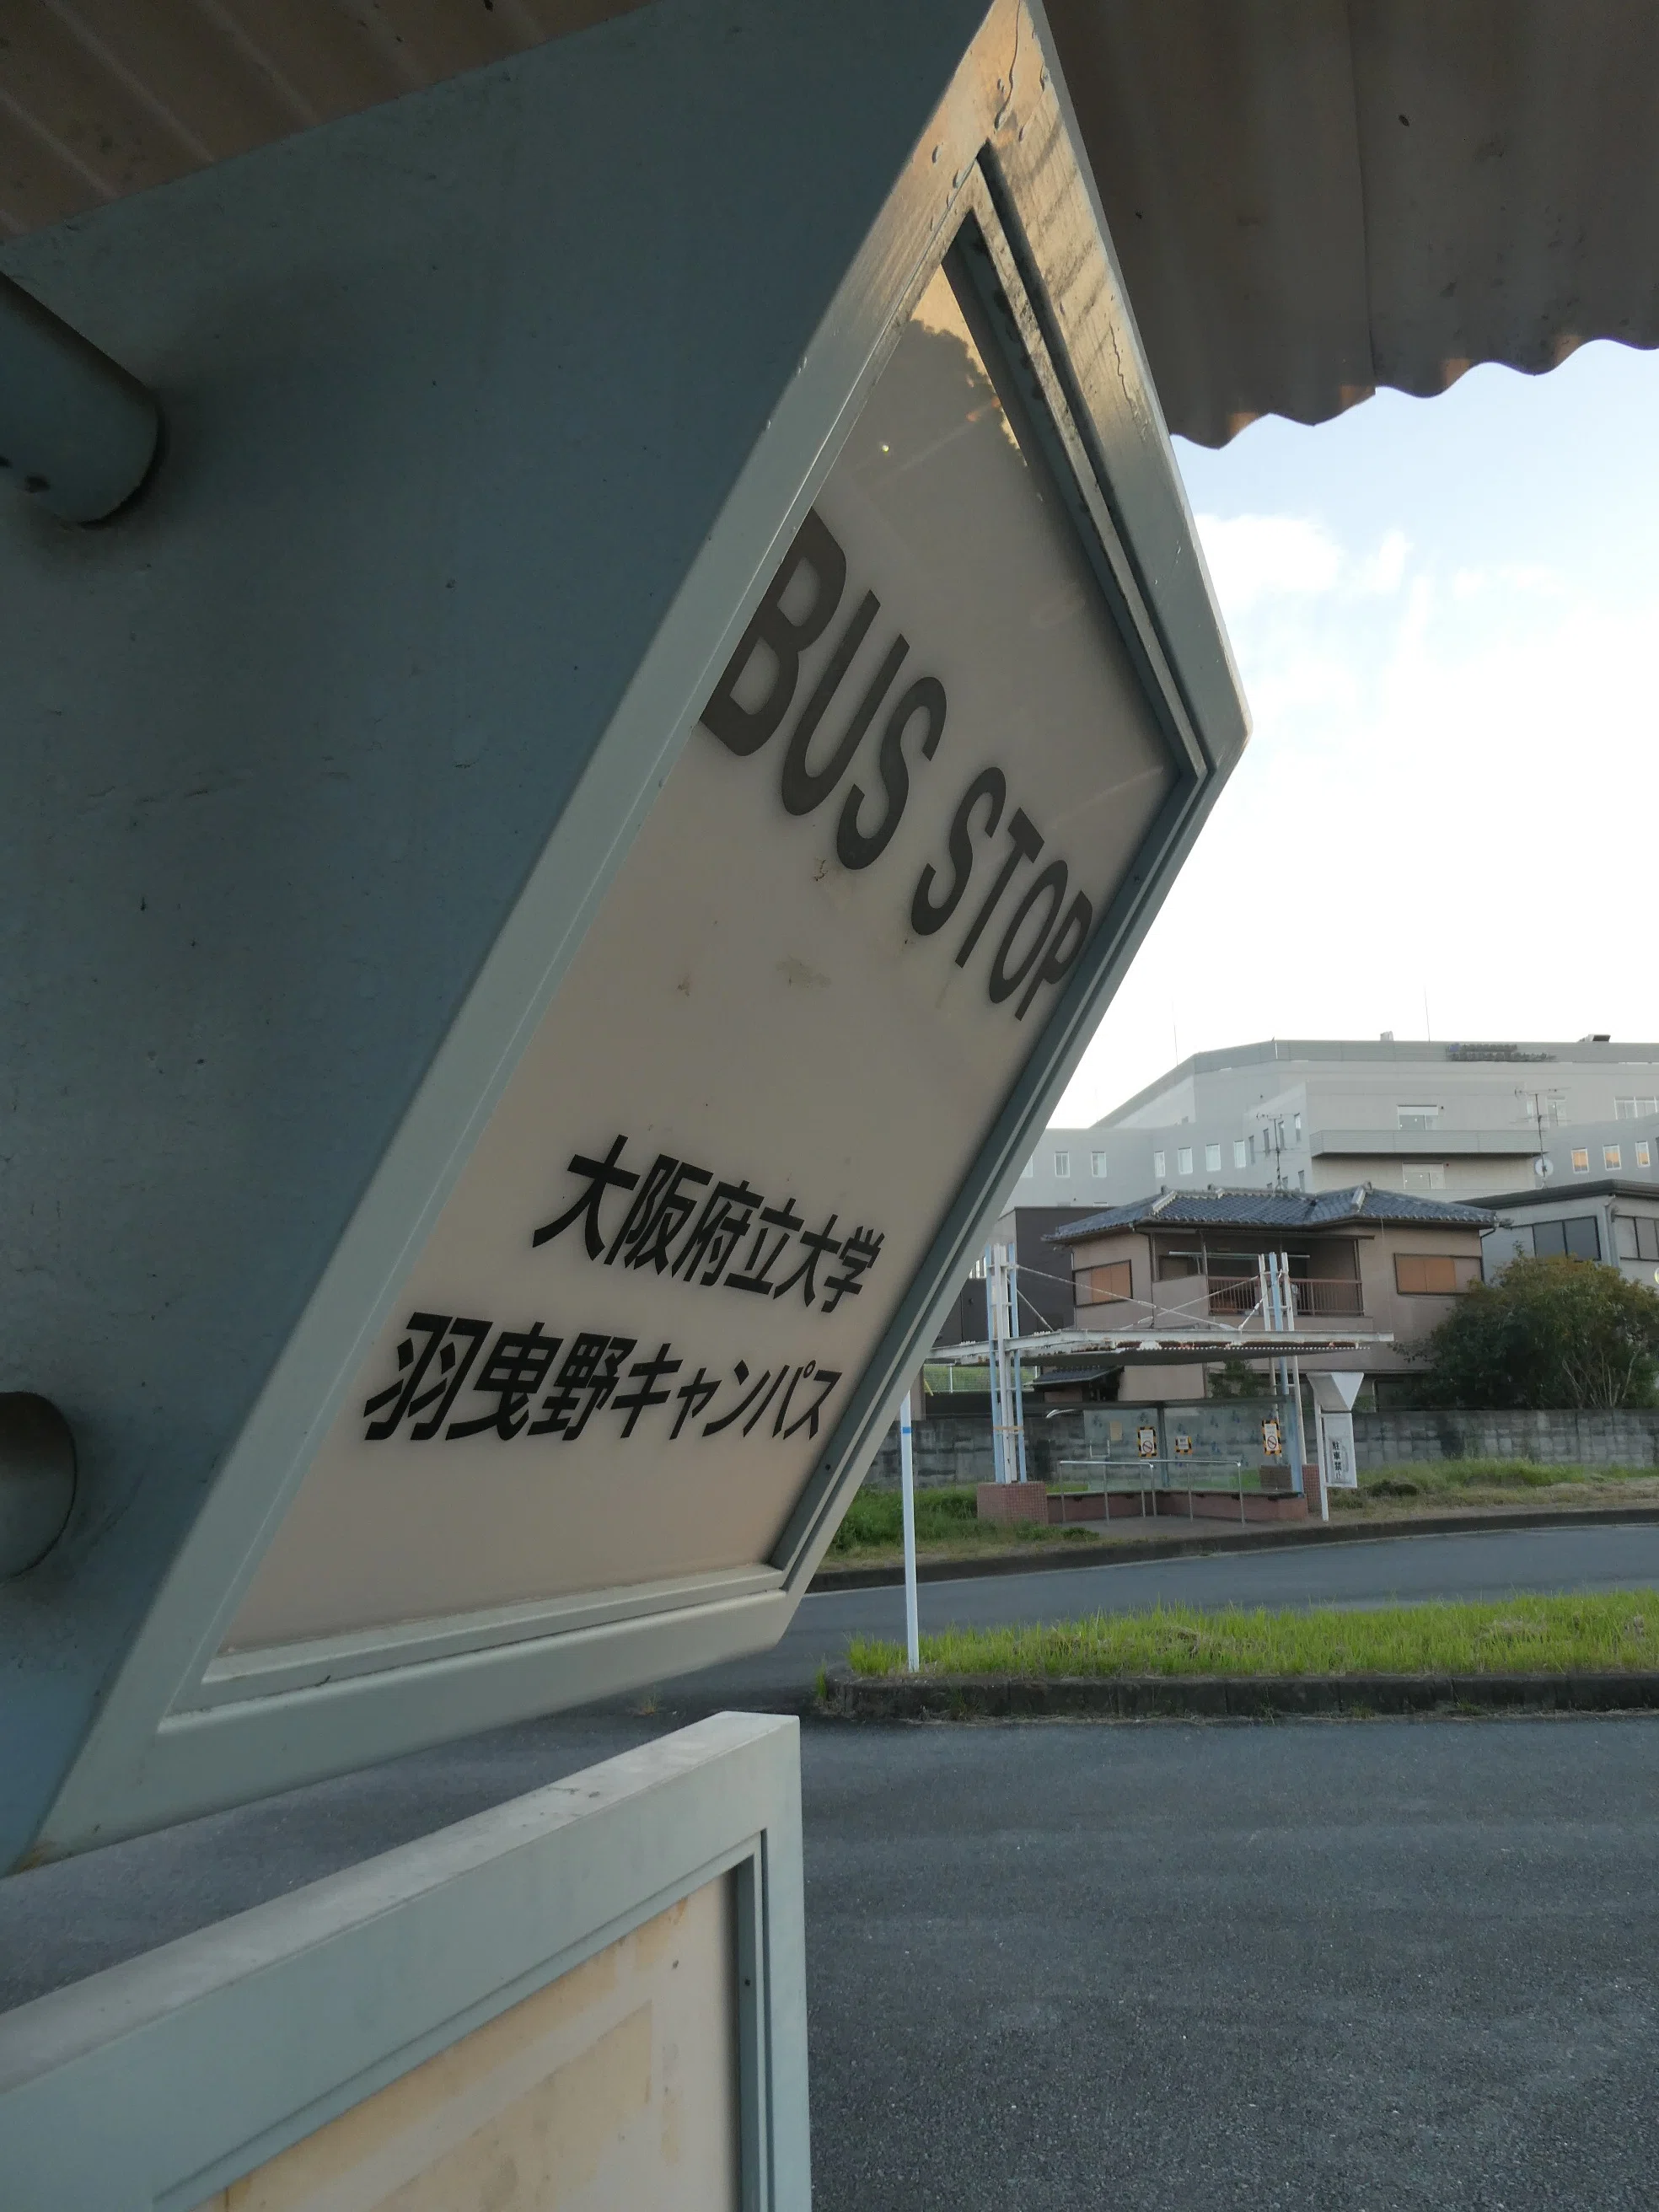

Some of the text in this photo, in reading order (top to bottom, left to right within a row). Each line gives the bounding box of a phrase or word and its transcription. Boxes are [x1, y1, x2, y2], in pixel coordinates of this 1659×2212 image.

[699, 506, 1093, 1022] BUS STOP
[532, 1134, 885, 1313] 大阪府立大学
[363, 1312, 842, 1442] 羽曳野キャンパス
[1332, 1441, 1342, 1480] 駐車禁止
